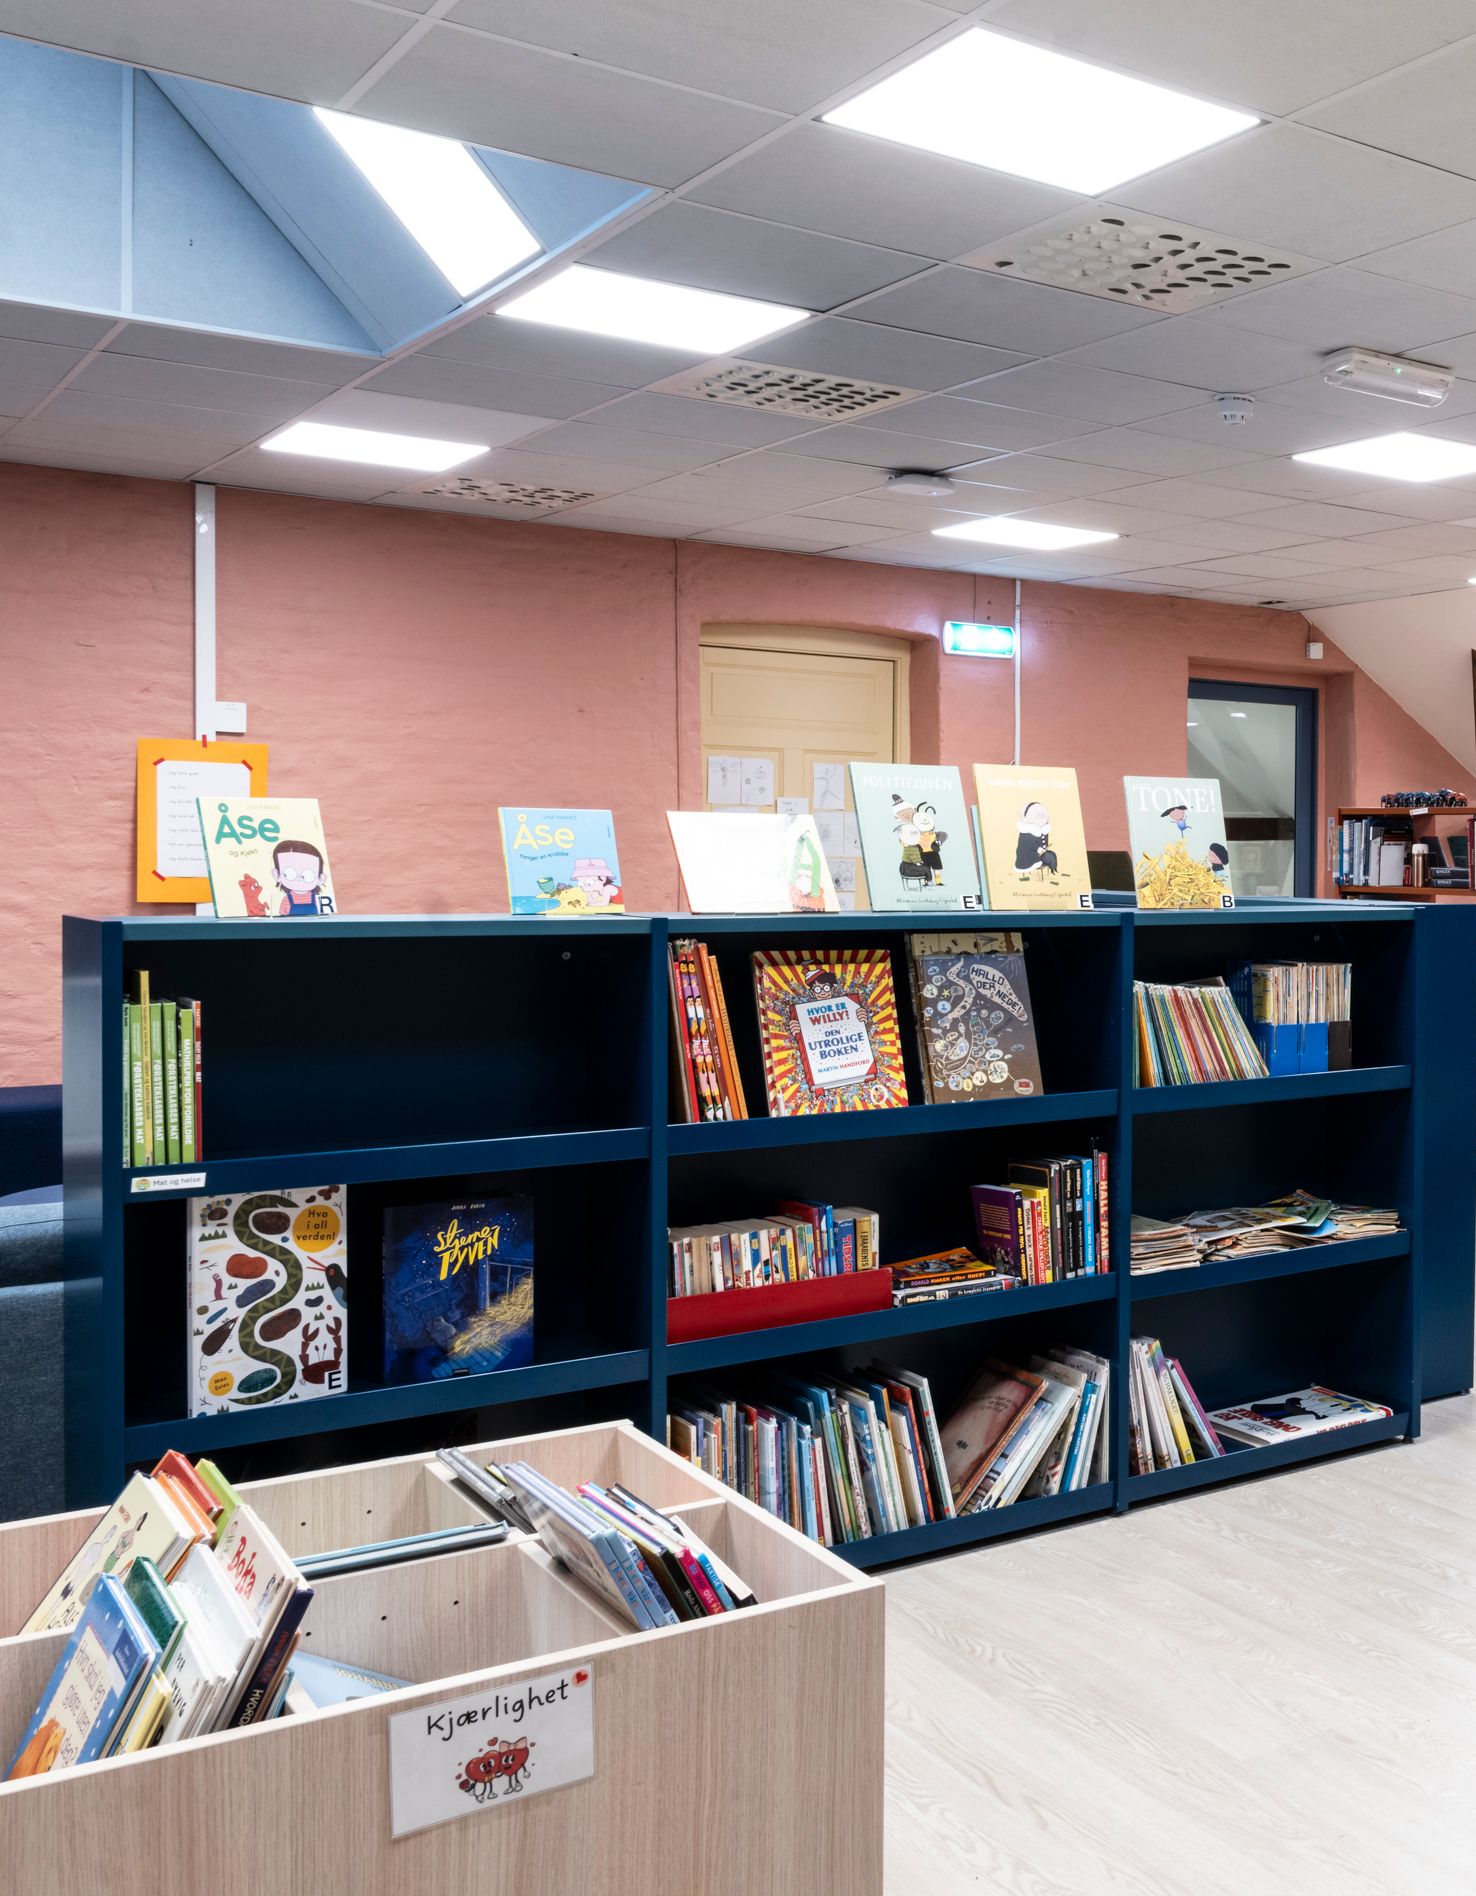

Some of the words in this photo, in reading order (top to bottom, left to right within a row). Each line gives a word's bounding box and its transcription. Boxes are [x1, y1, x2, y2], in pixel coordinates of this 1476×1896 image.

[1132, 785, 1217, 813] TONE!
[215, 803, 281, 845] Åse
[513, 813, 576, 850] Åse
[319, 896, 335, 914] R
[963, 896, 974, 909] E
[1080, 895, 1092, 908] E
[1222, 895, 1234, 908] B
[970, 966, 1005, 986] HALLO
[976, 980, 996, 991] DER
[807, 1004, 833, 1016] HVOR
[835, 1002, 847, 1012] ER
[808, 1032, 865, 1051] UTROLIGE
[824, 1029, 841, 1038] DEN
[819, 1044, 859, 1060] BOKEN
[817, 1063, 839, 1074] MARTIN
[839, 1058, 871, 1070] HANDFORD
[133, 1062, 143, 1128] FØRSTEKLASSES
[152, 1060, 163, 1124] FØRSTEKLASSES
[167, 1059, 177, 1123] FØRSTEKLASSES
[135, 1129, 145, 1144] MAT
[155, 1126, 164, 1141] MAT
[170, 1125, 178, 1140] MAT
[153, 1179, 167, 1187] Mat
[169, 1179, 179, 1189] og
[181, 1175, 201, 1185] helse
[1099, 1181, 1108, 1214] HALL
[307, 1209, 329, 1219] Hva
[307, 1220, 311, 1230] i
[313, 1220, 328, 1230] all
[296, 1231, 337, 1241] verden!
[1100, 1221, 1109, 1257] FAME
[438, 1226, 501, 1281] TYVEN
[328, 1370, 343, 1390] E
[428, 1678, 569, 1743] Kjærlighet
